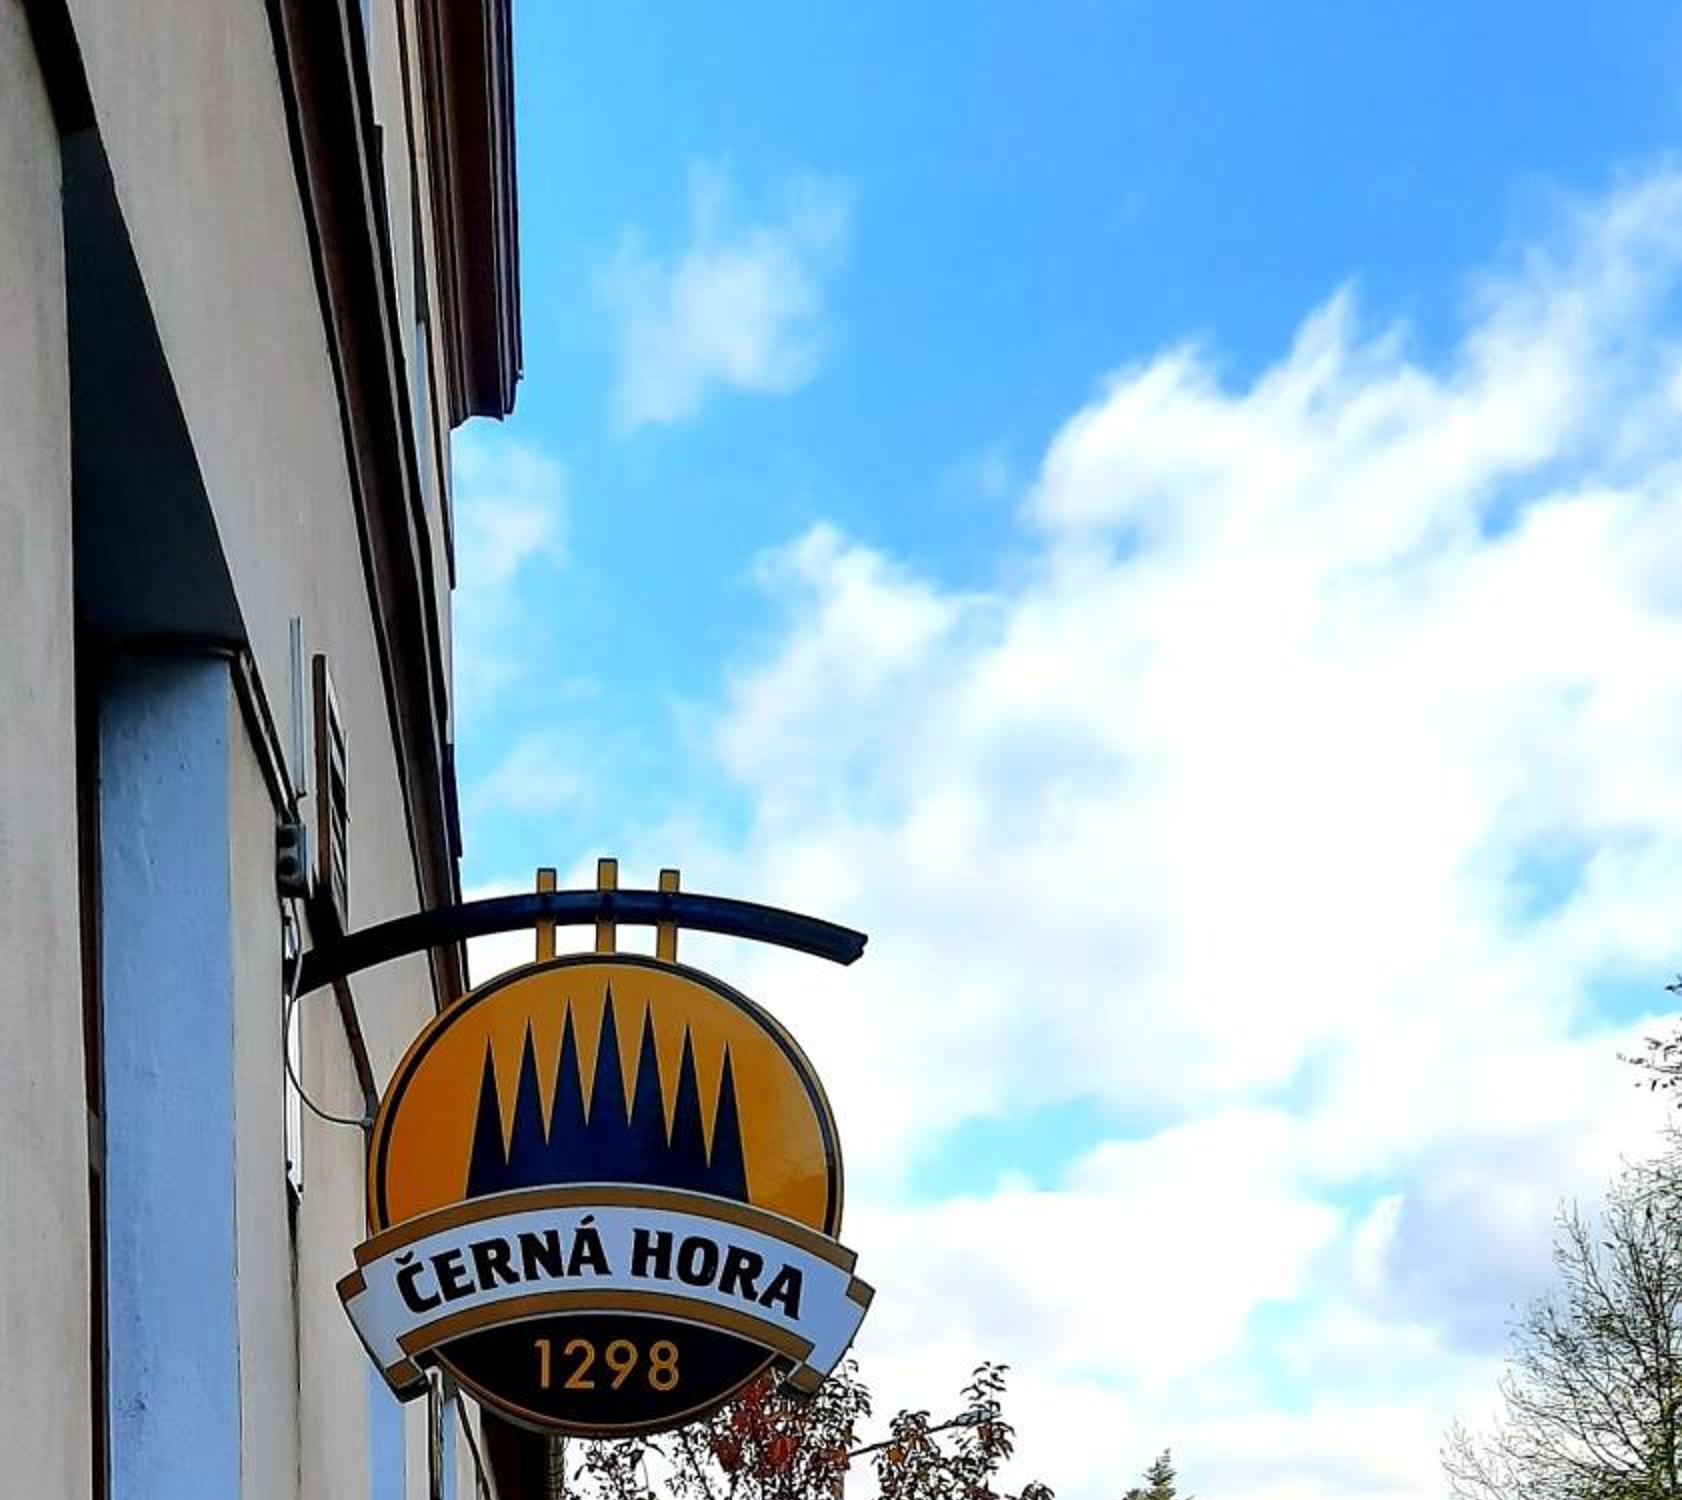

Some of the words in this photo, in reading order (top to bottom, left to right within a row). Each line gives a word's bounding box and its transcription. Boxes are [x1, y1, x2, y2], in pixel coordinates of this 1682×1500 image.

[396, 1215, 610, 1314] ČERNÁ
[631, 1228, 803, 1320] HORA
[533, 1338, 681, 1391] 1298
